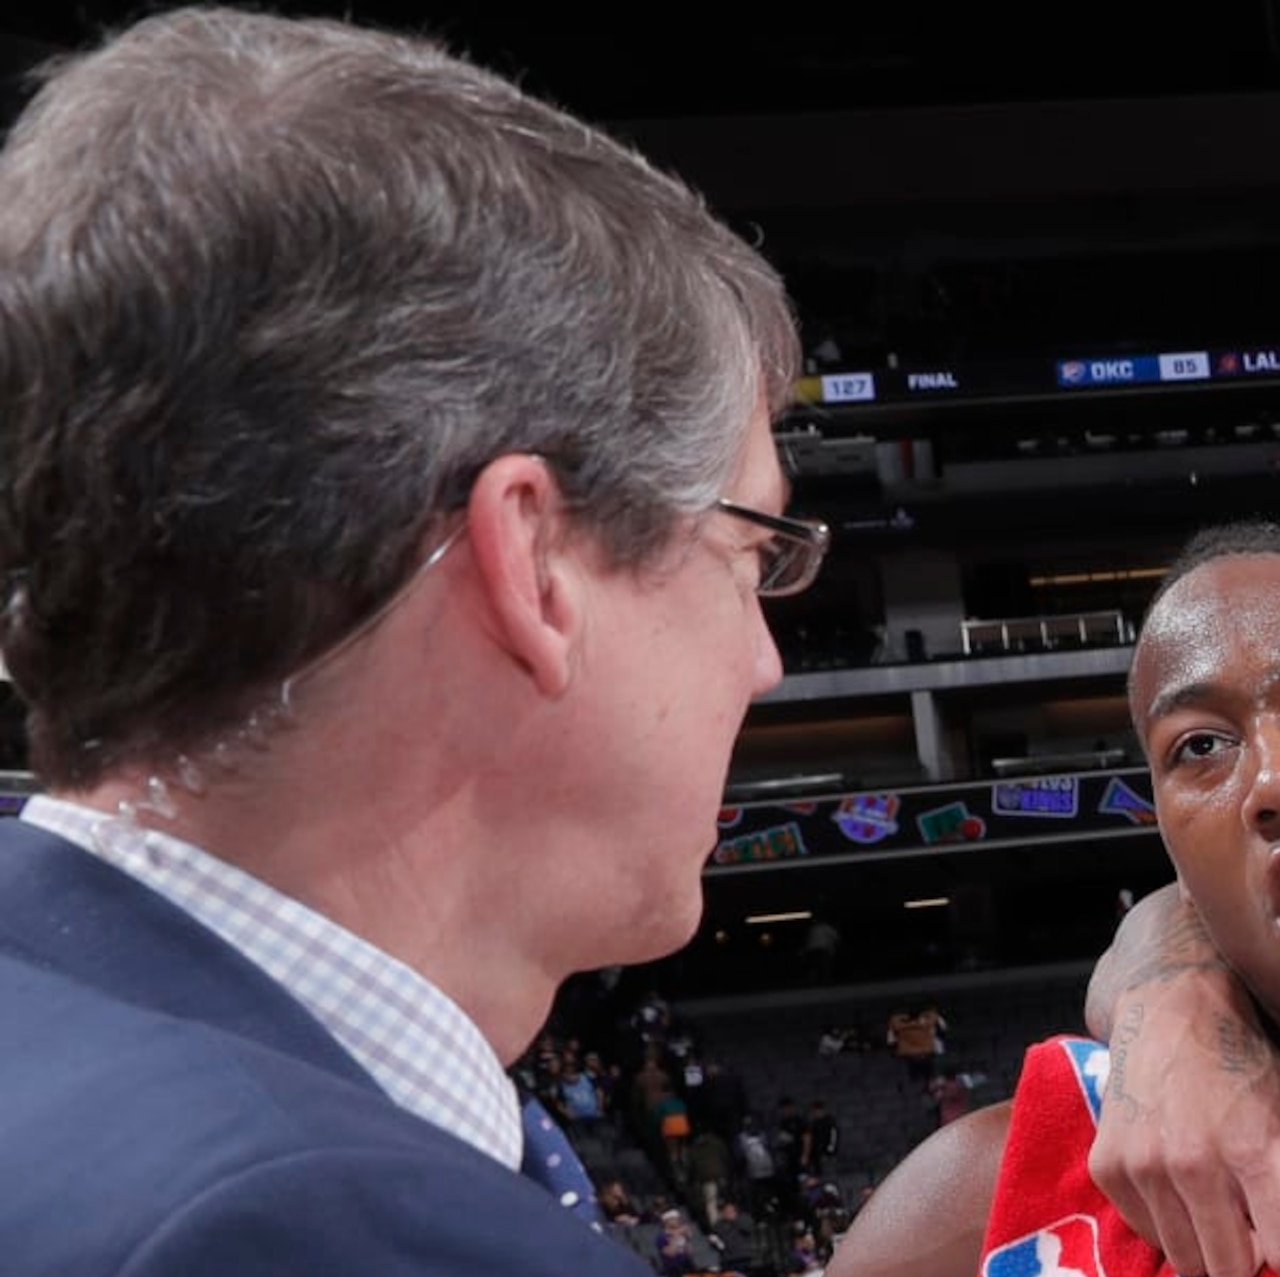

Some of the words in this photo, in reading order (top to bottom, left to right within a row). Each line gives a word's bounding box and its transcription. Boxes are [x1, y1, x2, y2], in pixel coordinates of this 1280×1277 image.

[1091, 360, 1134, 380] OKC
[1243, 351, 1280, 372] LAL
[832, 379, 868, 397] 127
[908, 372, 958, 389] FINAL
